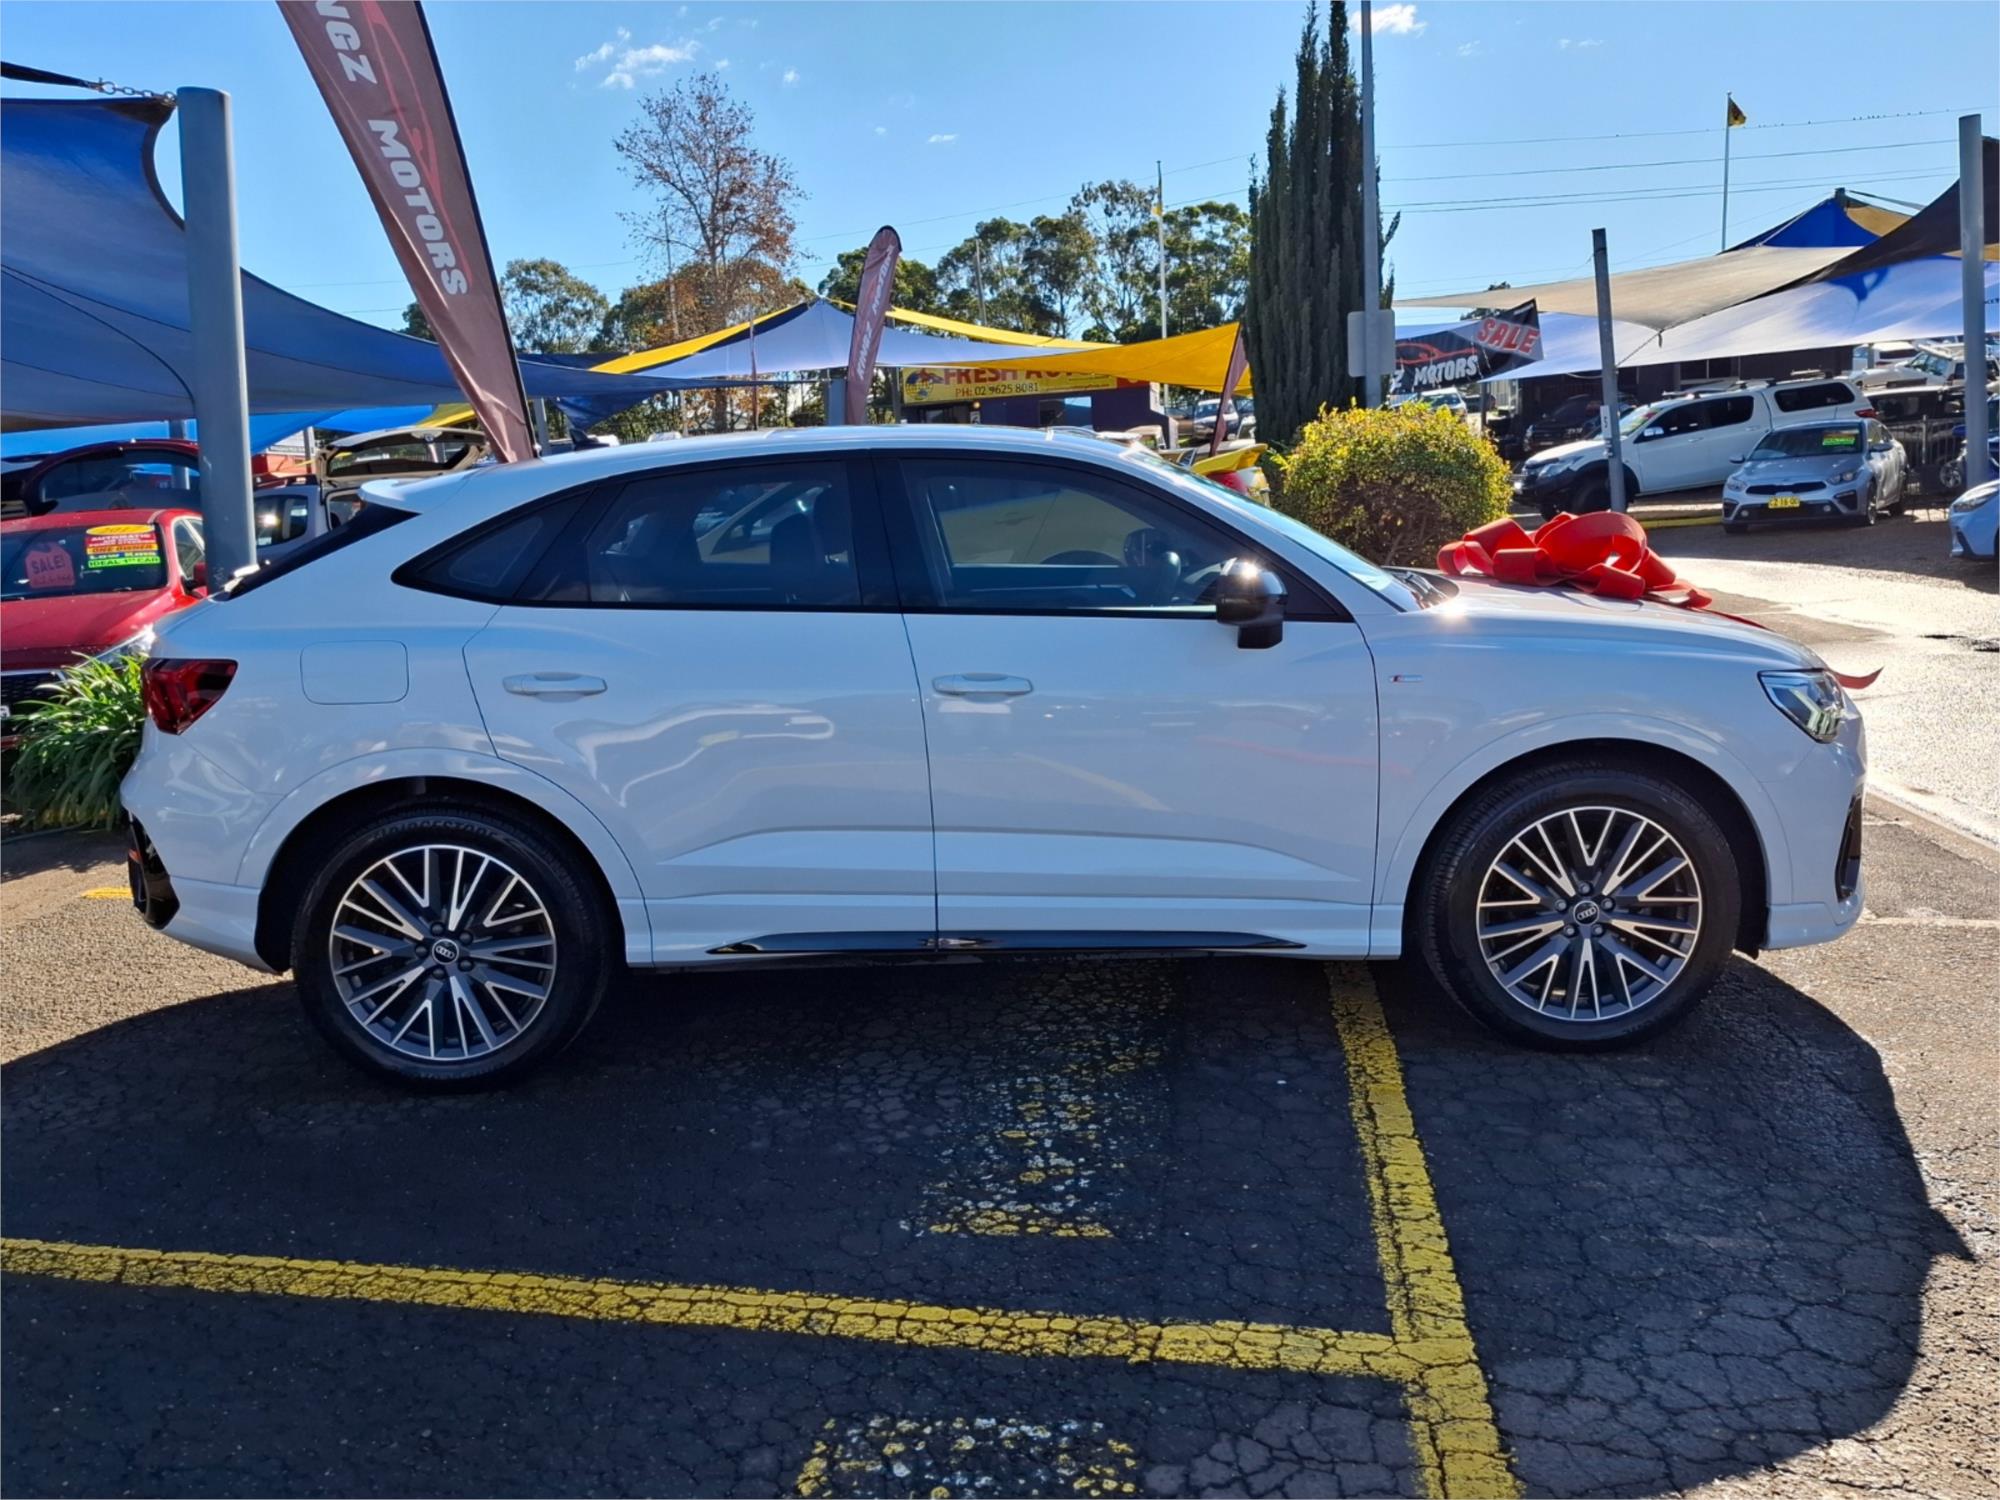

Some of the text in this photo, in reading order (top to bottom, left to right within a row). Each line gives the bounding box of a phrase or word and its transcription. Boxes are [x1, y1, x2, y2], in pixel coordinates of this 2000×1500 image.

[367, 119, 468, 295] MOTORS
[857, 244, 895, 382] KINGZ MOTORS
[1477, 317, 1540, 354] SALE
[944, 367, 1018, 385] FRESH
[1413, 355, 1479, 387] MOTORS
[955, 388, 972, 398] PH:
[974, 386, 986, 396] 02
[989, 384, 1013, 394] 9625
[1015, 382, 1038, 393] 8081
